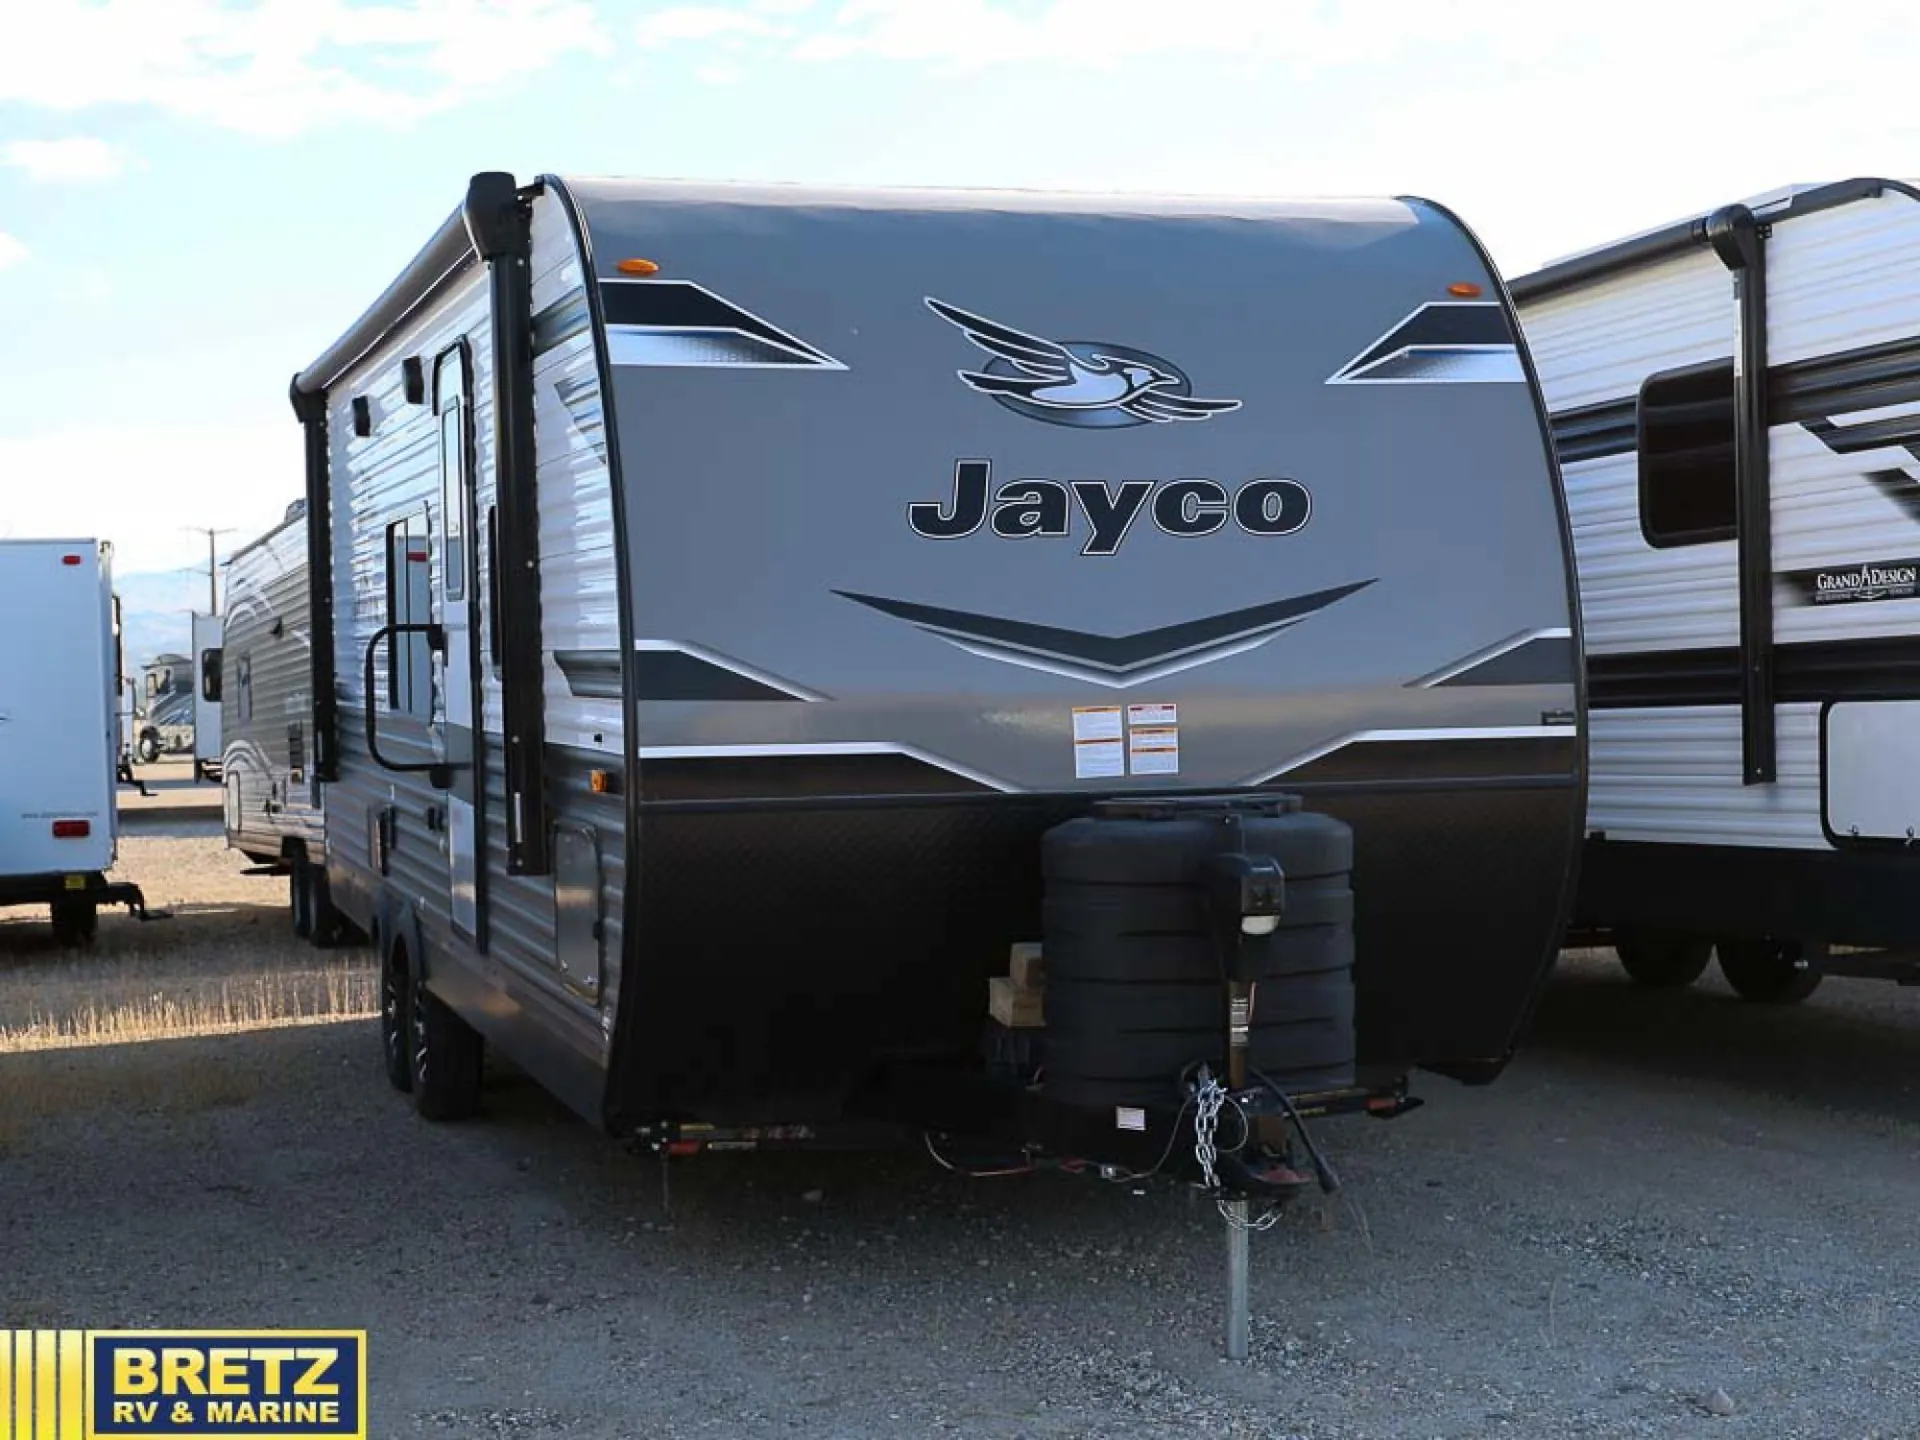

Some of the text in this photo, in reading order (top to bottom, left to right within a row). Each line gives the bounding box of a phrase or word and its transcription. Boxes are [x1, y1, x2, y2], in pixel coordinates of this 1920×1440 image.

[907, 458, 1312, 556] Jayco
[1817, 567, 1917, 589] GRAND DESIGN
